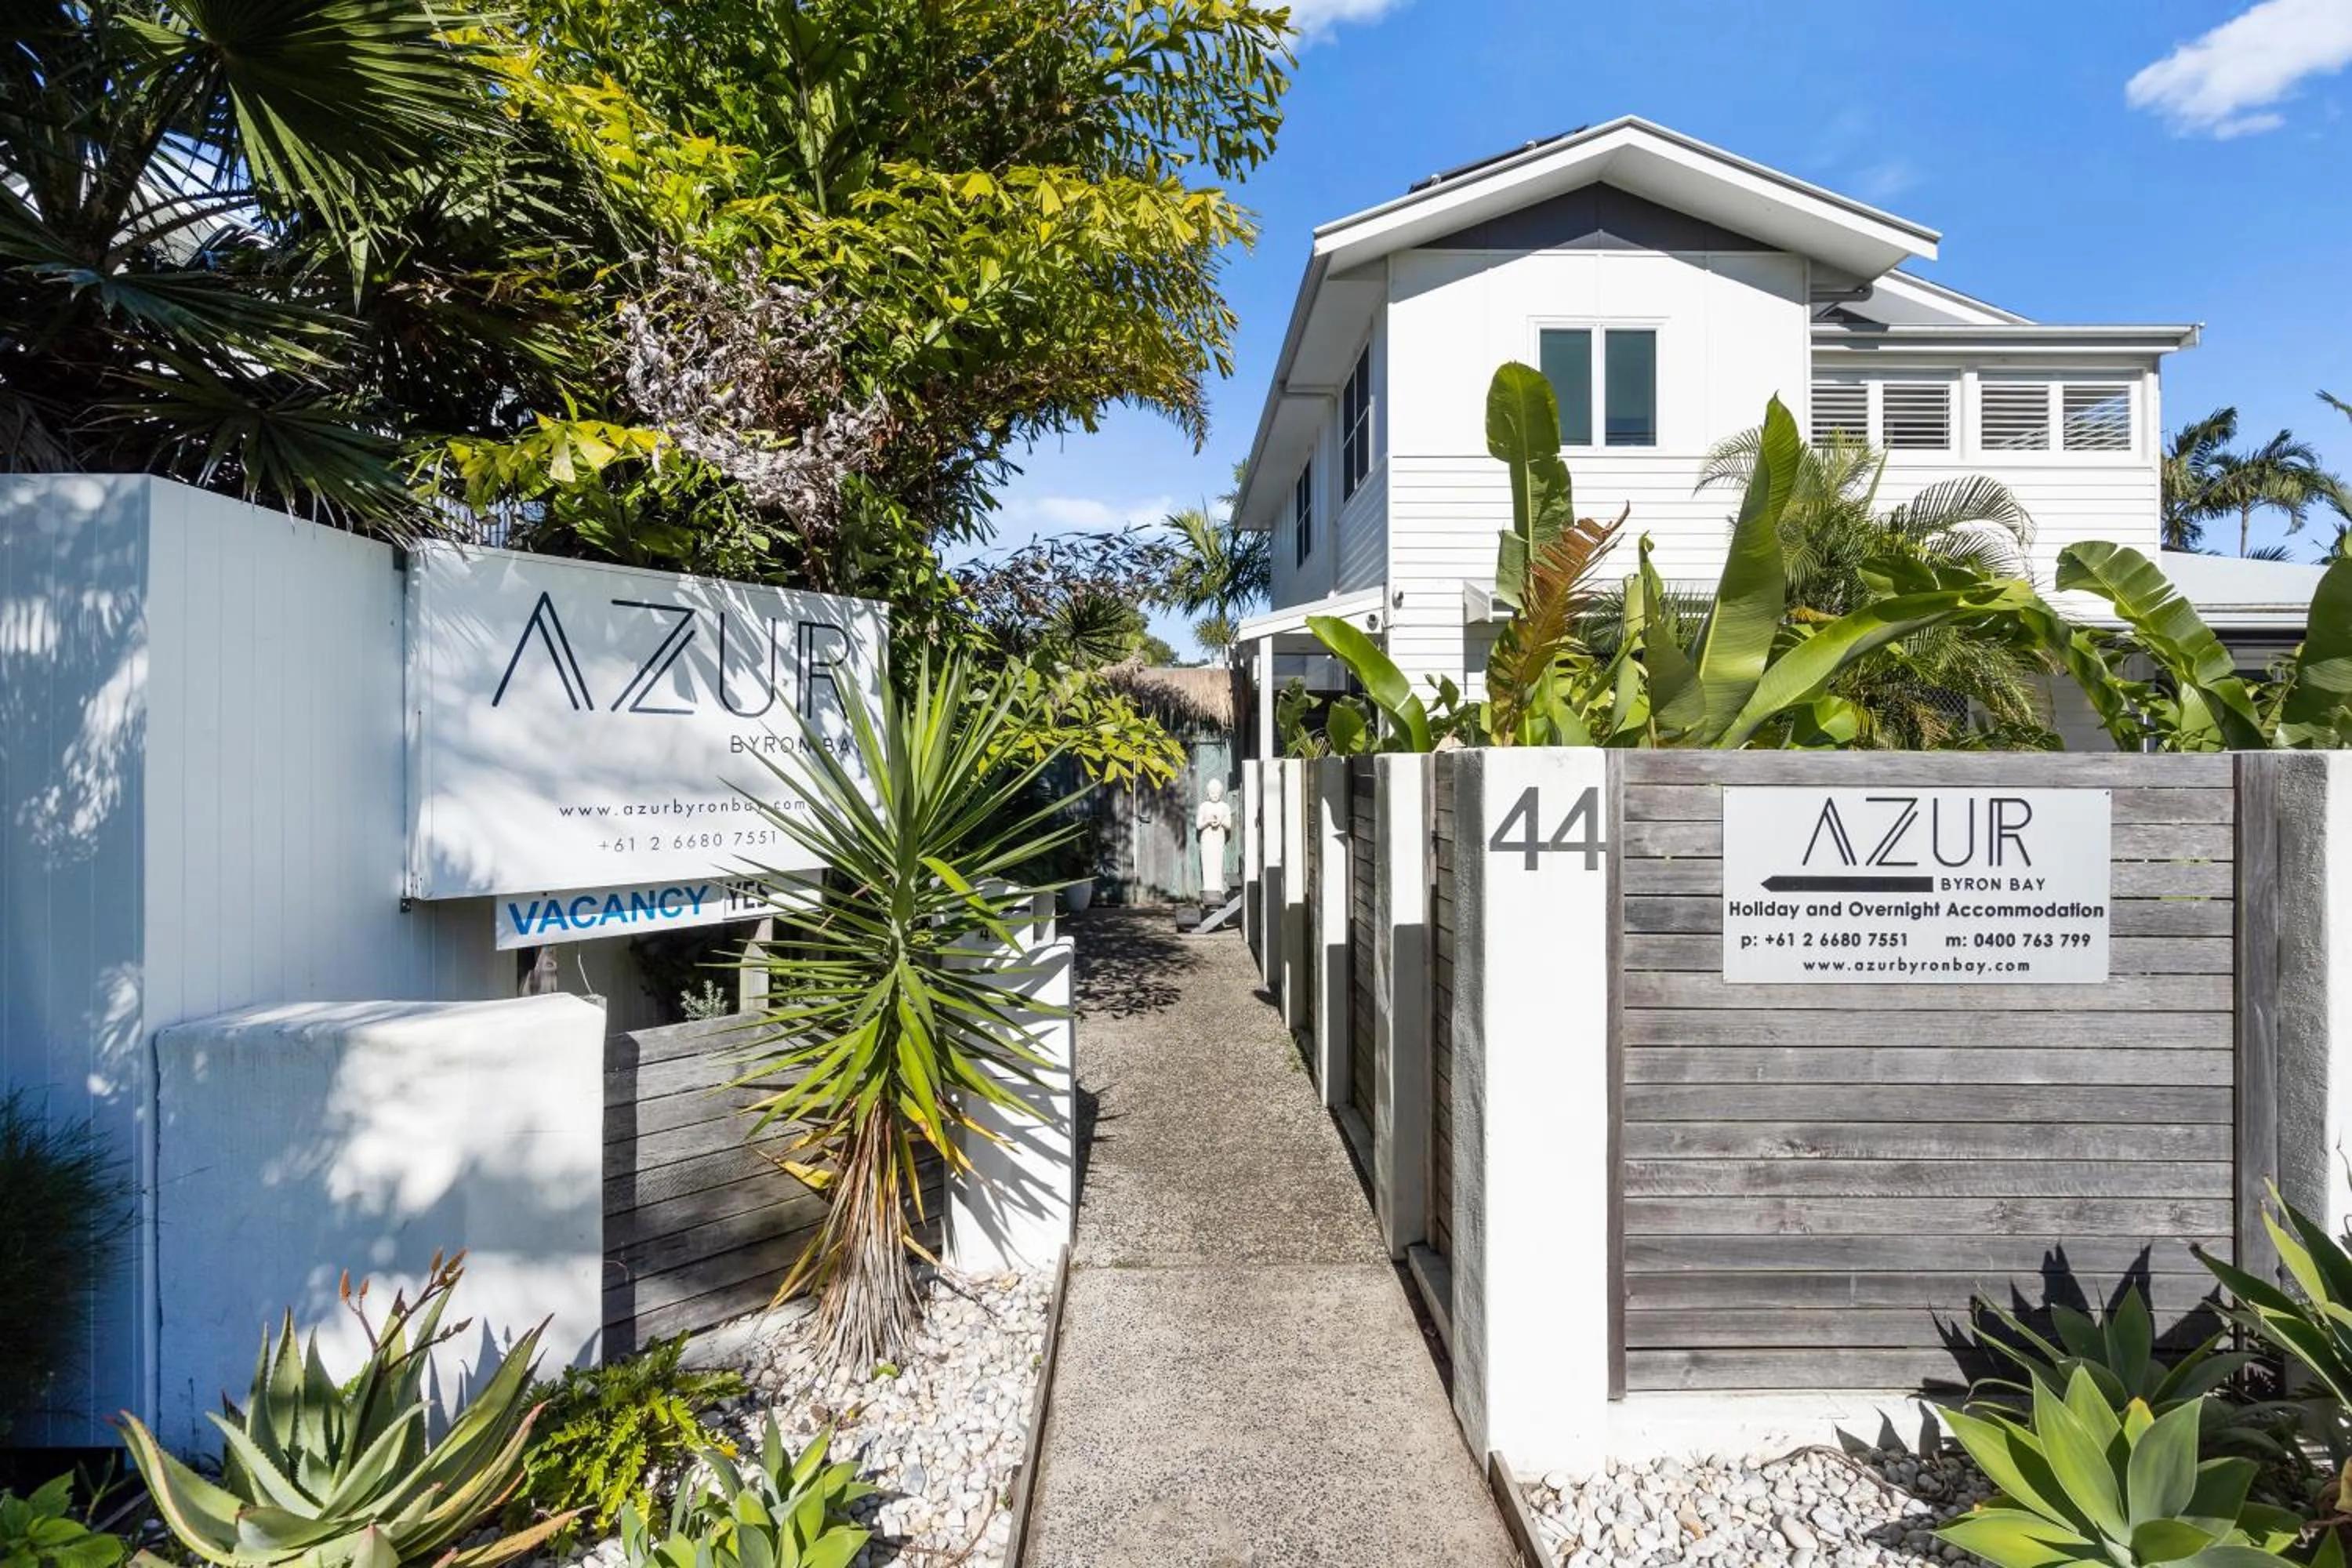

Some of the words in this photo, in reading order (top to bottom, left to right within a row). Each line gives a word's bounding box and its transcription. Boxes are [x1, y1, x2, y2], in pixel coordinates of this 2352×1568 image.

[492, 590, 850, 719] AZUR
[731, 735, 812, 753] BYRON
[823, 737, 862, 754] BA
[1489, 786, 1606, 870] 44
[1802, 797, 2033, 867] AZUR
[598, 837, 636, 853] +61
[650, 836, 661, 851] 2
[673, 832, 724, 850] 6680
[733, 829, 777, 847] 7551
[1940, 877, 2002, 891] BYRON
[2009, 877, 2046, 891] BAY
[507, 884, 709, 935] VACANCY
[725, 879, 769, 910] YES
[1729, 901, 1800, 920] Holiday
[1806, 901, 1842, 916] and
[1848, 901, 1940, 920] Overnight
[1946, 902, 2105, 918] Accommodation
[1740, 934, 1758, 949] p:
[1764, 932, 1795, 947] +61
[1802, 932, 1813, 947] 2
[1819, 932, 1862, 947] 6680
[1867, 932, 1908, 947] 7551
[1944, 935, 1967, 948] m:
[1973, 933, 2016, 948] 0400
[2022, 933, 2054, 948] 763
[2060, 934, 2092, 948] 799
[1802, 956, 2031, 975] www.azurbyronbay.com
